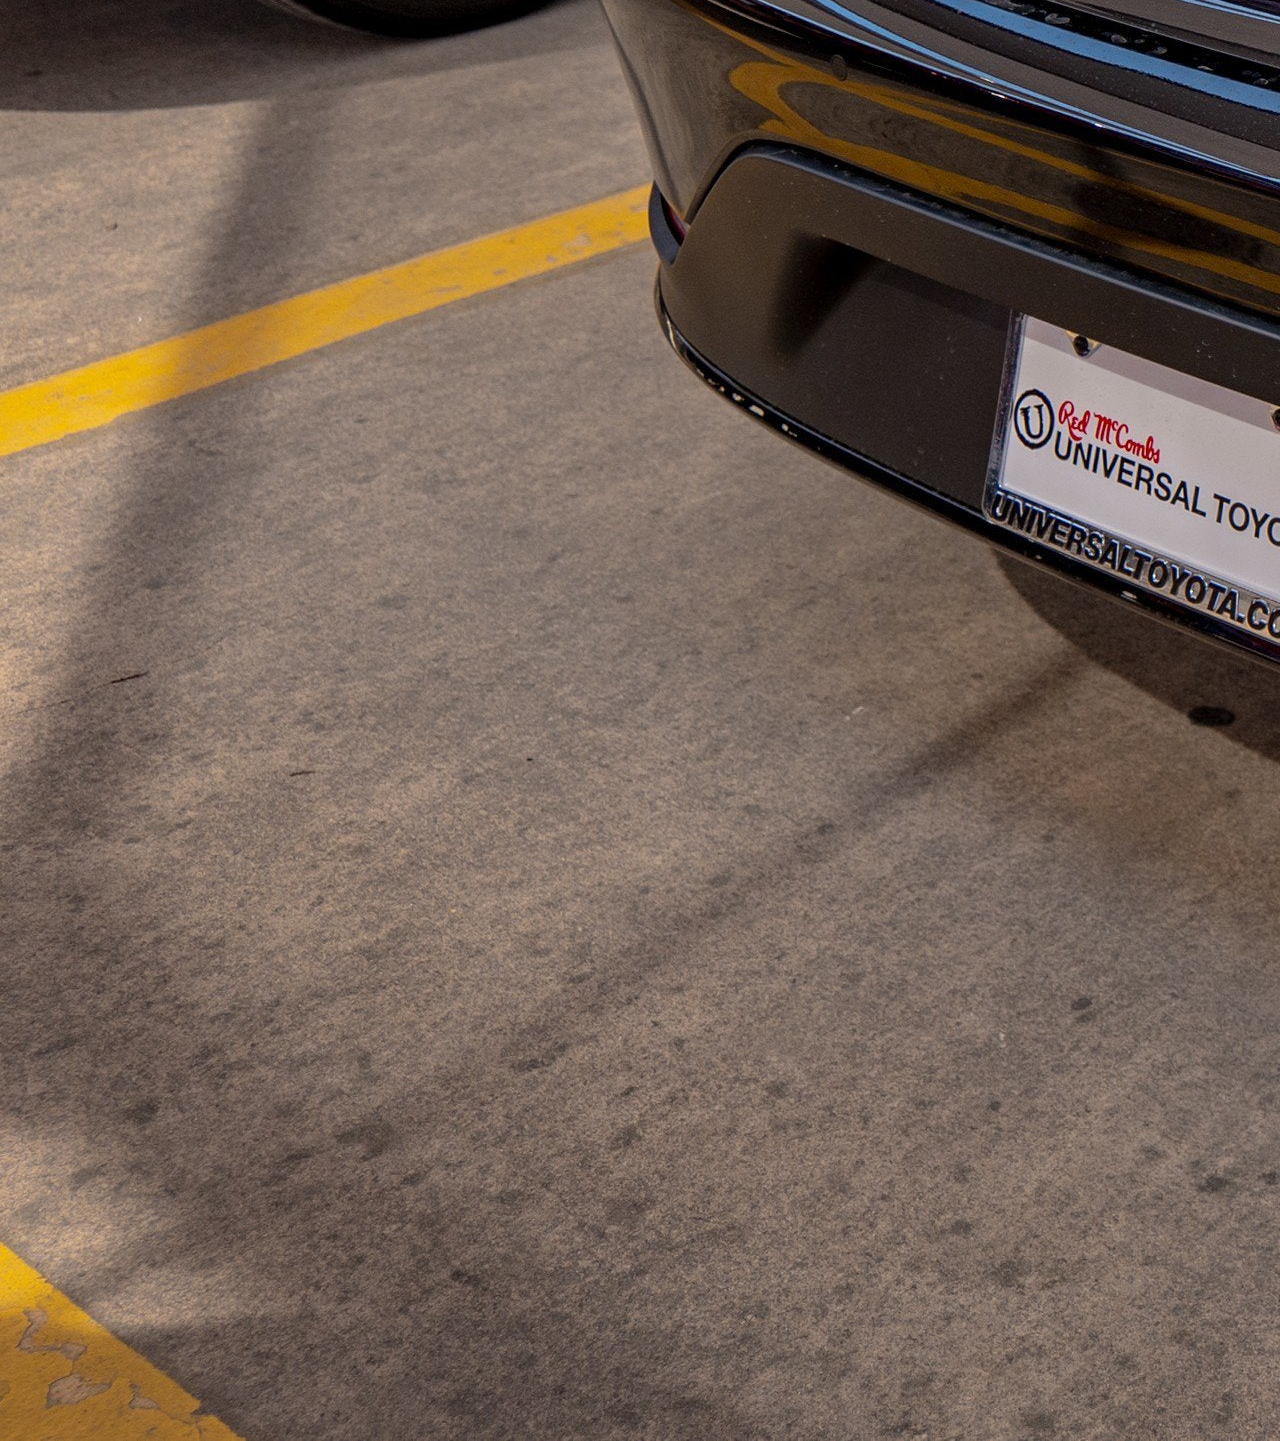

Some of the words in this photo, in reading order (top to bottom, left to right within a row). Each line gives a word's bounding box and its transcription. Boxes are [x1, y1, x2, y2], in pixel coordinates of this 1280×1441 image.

[1058, 400, 1091, 442] Red
[1094, 412, 1160, 464] McCombs
[1054, 431, 1206, 518] UNIVERSAL
